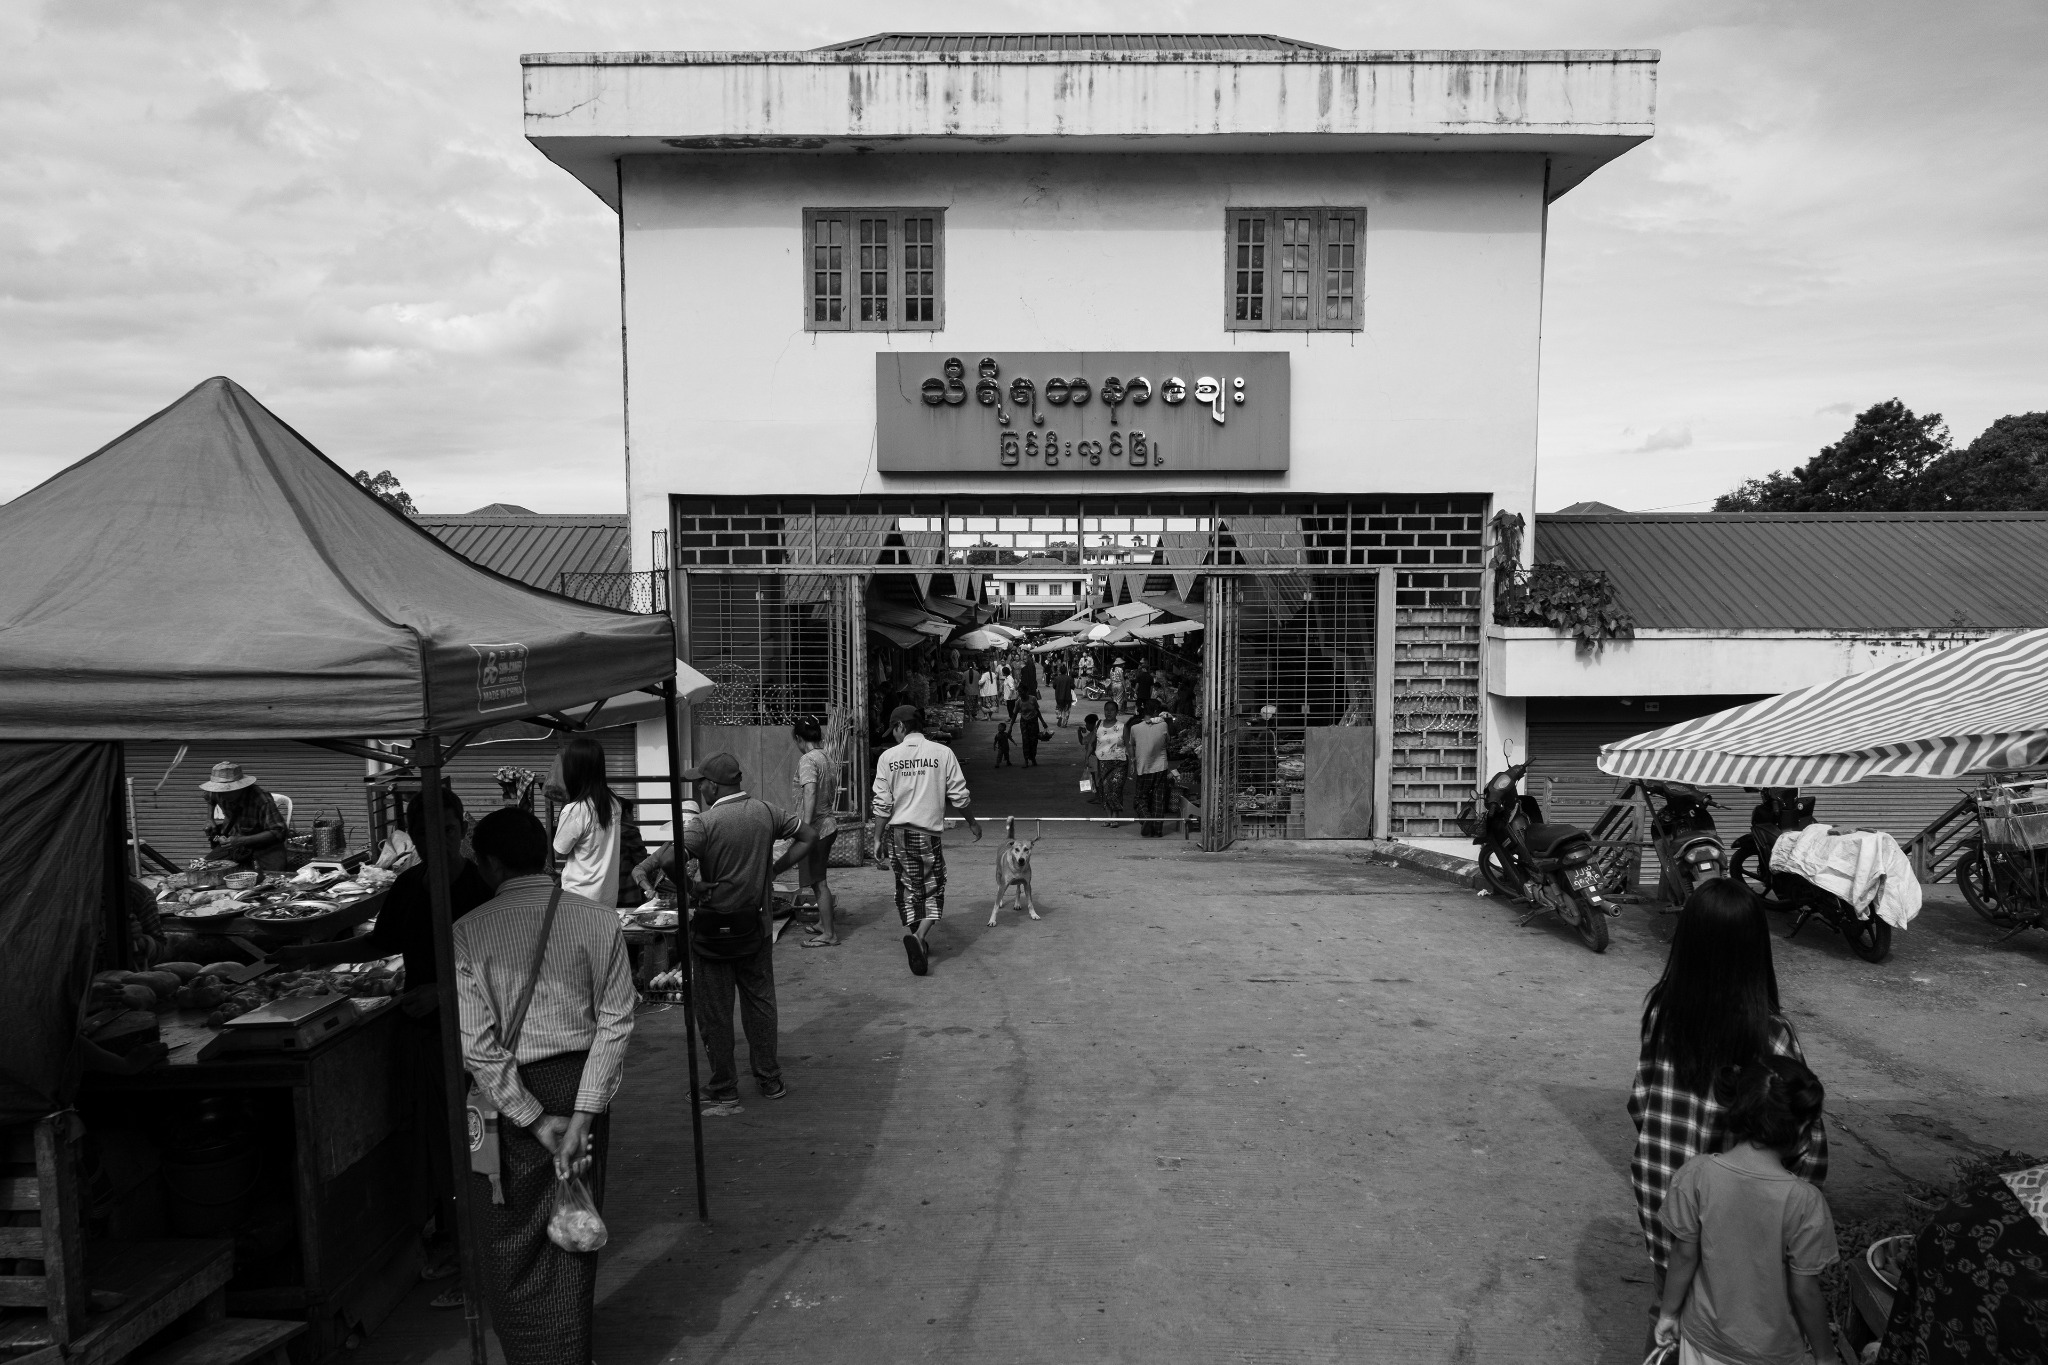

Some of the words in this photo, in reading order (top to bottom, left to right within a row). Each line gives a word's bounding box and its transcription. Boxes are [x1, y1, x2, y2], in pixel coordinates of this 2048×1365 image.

[482, 690, 500, 702] MADE
[500, 688, 506, 699] IN
[506, 686, 522, 698] CHINA
[888, 758, 939, 772] ESSENTIALS
